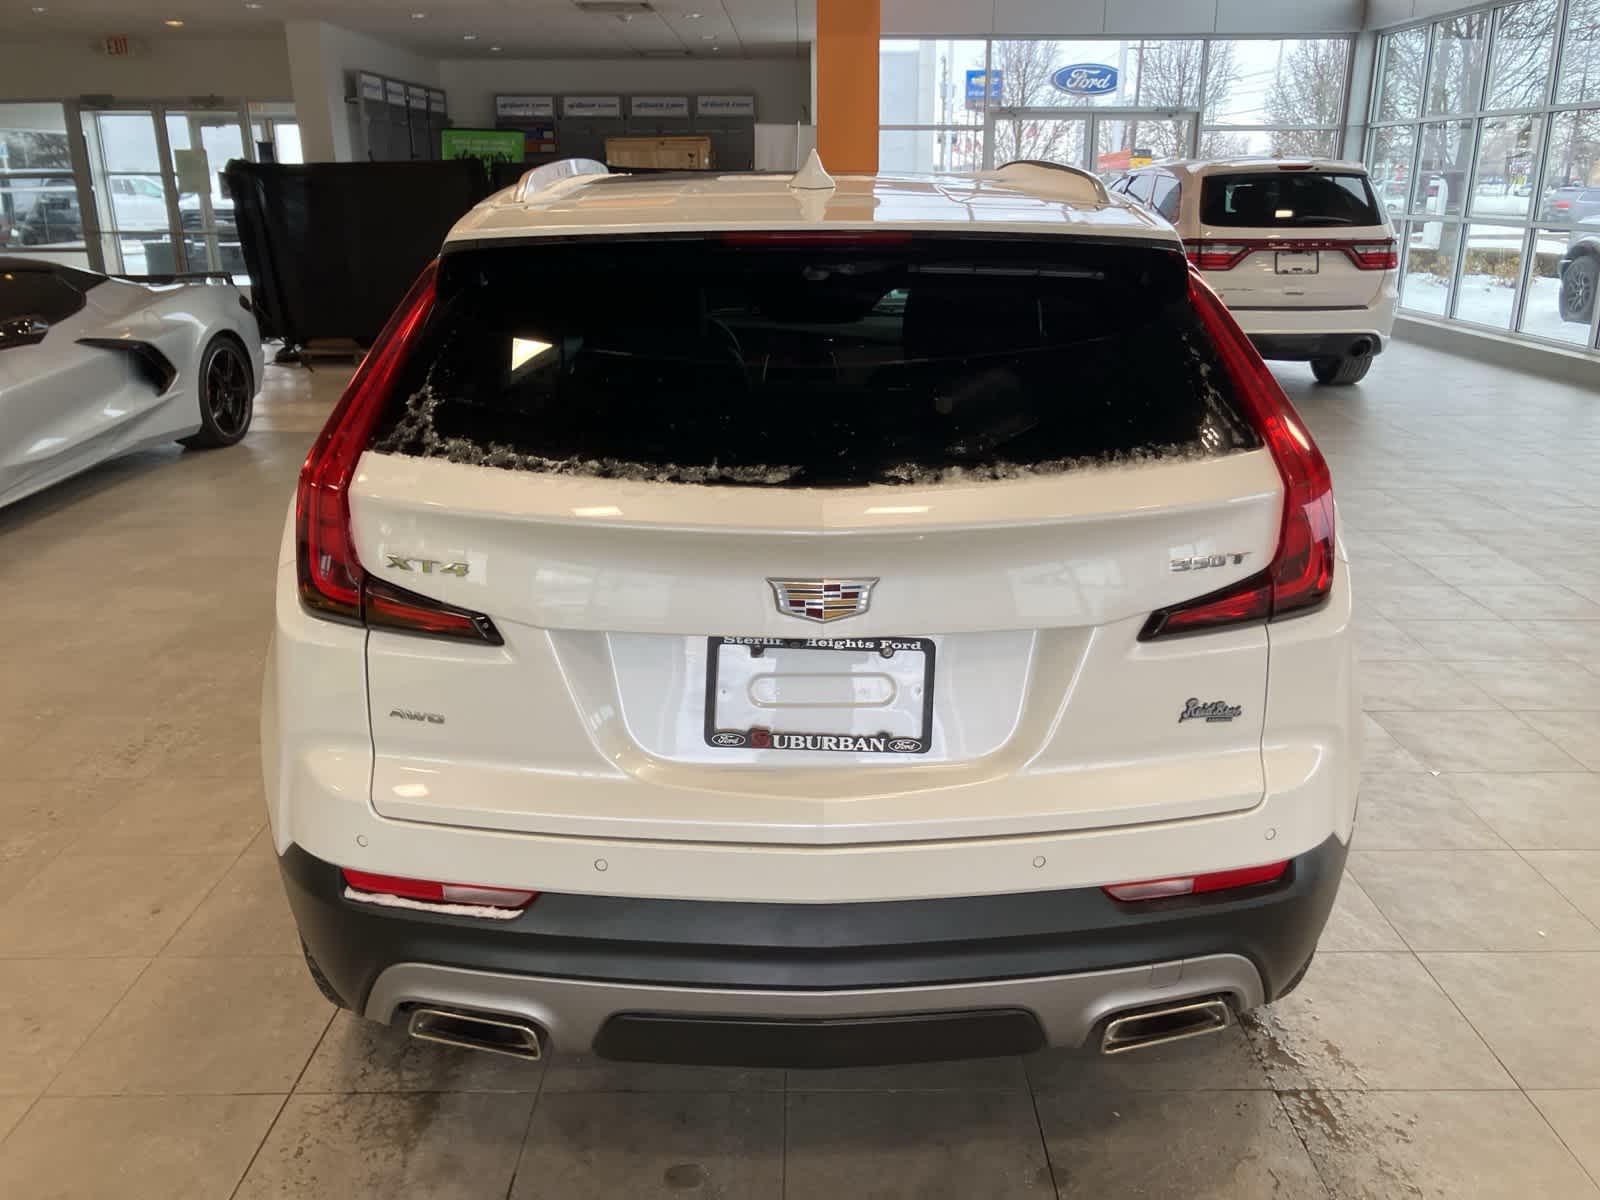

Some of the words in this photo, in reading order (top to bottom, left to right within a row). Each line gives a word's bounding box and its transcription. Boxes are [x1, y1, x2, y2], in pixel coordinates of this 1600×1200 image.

[1065, 68, 1112, 89] Ford
[385, 553, 470, 577] XT4
[722, 636, 786, 646] Sterlin
[879, 639, 922, 650] Ford
[717, 734, 741, 745] Ford
[893, 740, 917, 751] Ford
